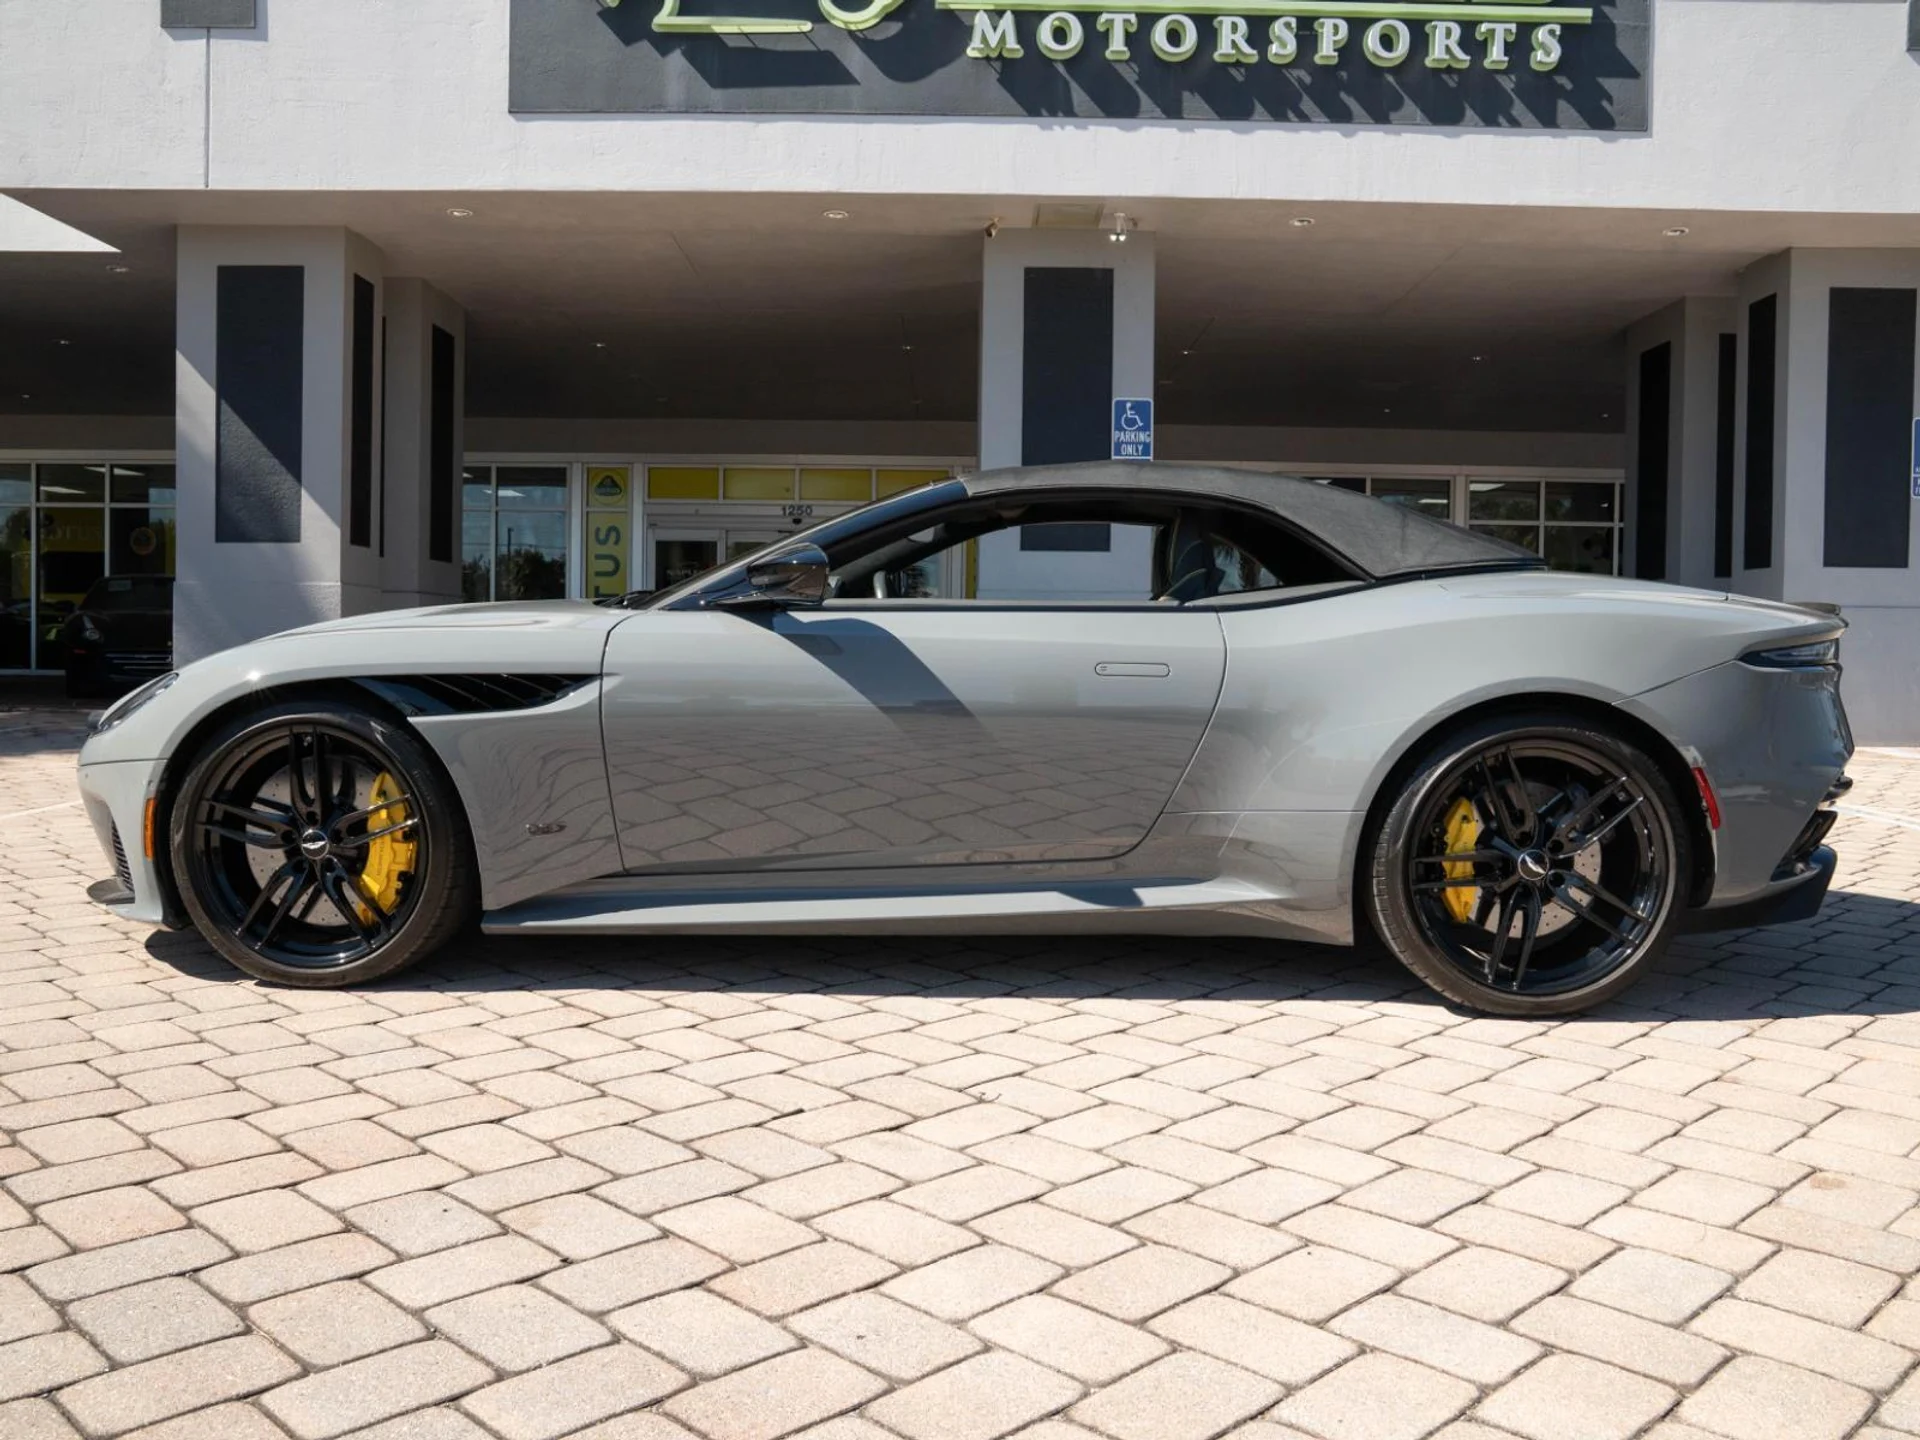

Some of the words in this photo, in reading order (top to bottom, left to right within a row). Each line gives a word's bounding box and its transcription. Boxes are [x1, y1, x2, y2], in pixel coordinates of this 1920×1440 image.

[967, 10, 1562, 71] MOTORSPORTS
[1114, 430, 1151, 443] PARKING
[1120, 443, 1144, 456] ONLY
[781, 504, 814, 517] 1250
